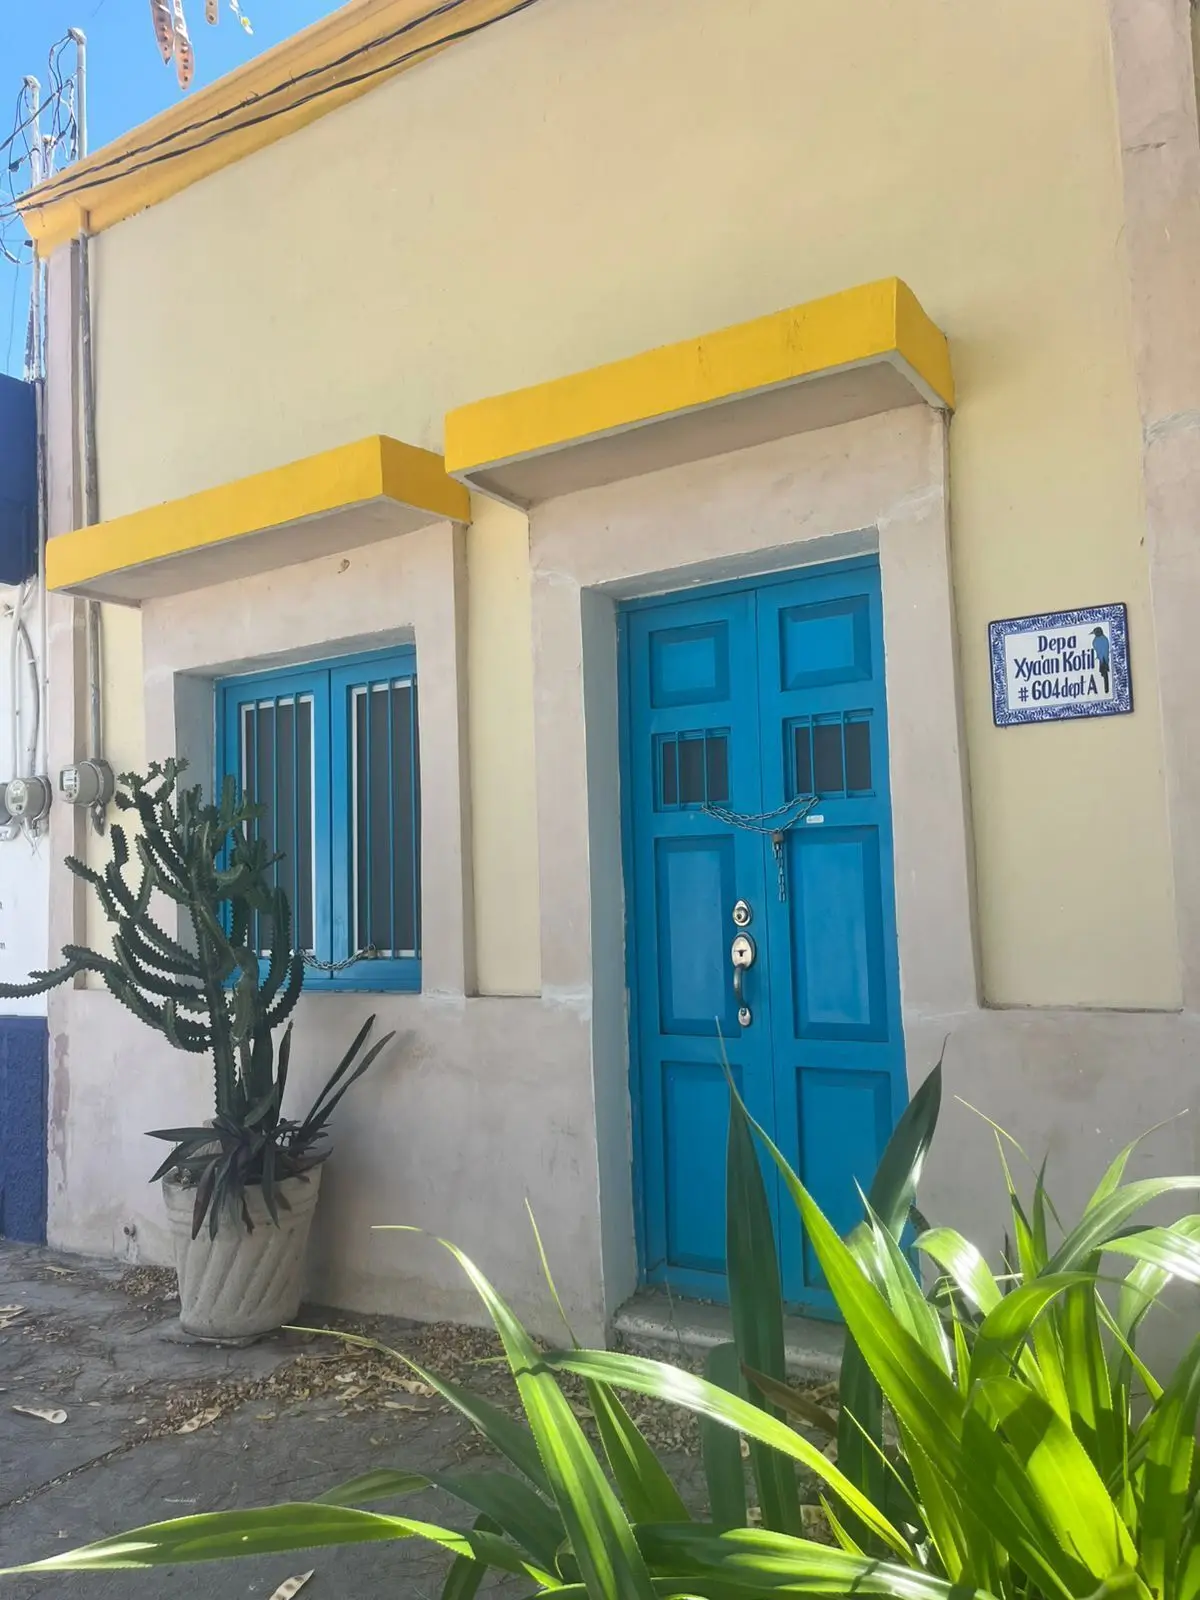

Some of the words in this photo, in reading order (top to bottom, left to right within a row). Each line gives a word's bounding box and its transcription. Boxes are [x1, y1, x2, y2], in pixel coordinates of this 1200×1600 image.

[1037, 635, 1077, 654] Depa
[1062, 648, 1095, 673] Kotil
[1087, 674, 1098, 695] A
